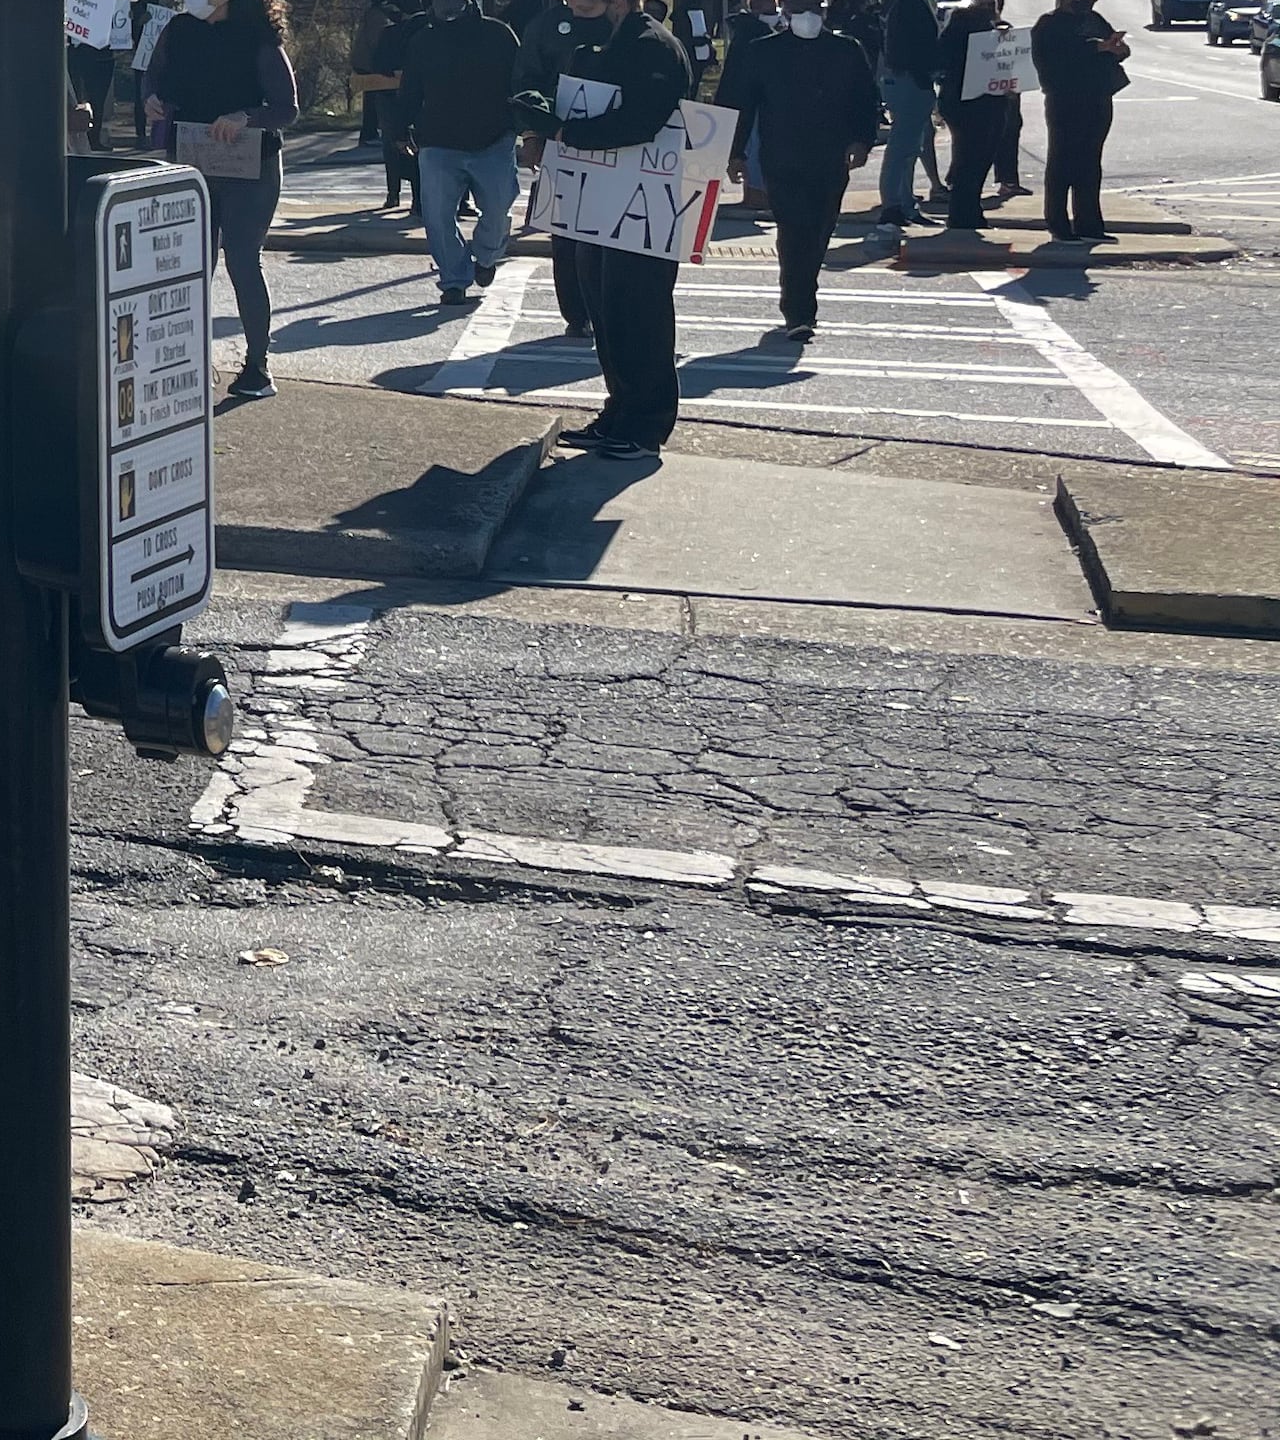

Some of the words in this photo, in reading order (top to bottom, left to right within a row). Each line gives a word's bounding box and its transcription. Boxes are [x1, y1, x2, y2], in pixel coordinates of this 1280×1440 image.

[641, 146, 678, 172] NO
[162, 198, 196, 222] CROSSING
[532, 164, 721, 265] DELAY!
[170, 286, 191, 309] START
[143, 381, 158, 403] TIME
[162, 369, 198, 397] REMAINING
[119, 385, 133, 421] 08
[171, 458, 193, 482] CROSS
[143, 537, 151, 559] TO
[155, 527, 178, 553] CROSS
[137, 586, 155, 611] PUSH
[159, 573, 185, 600] BUTTON
